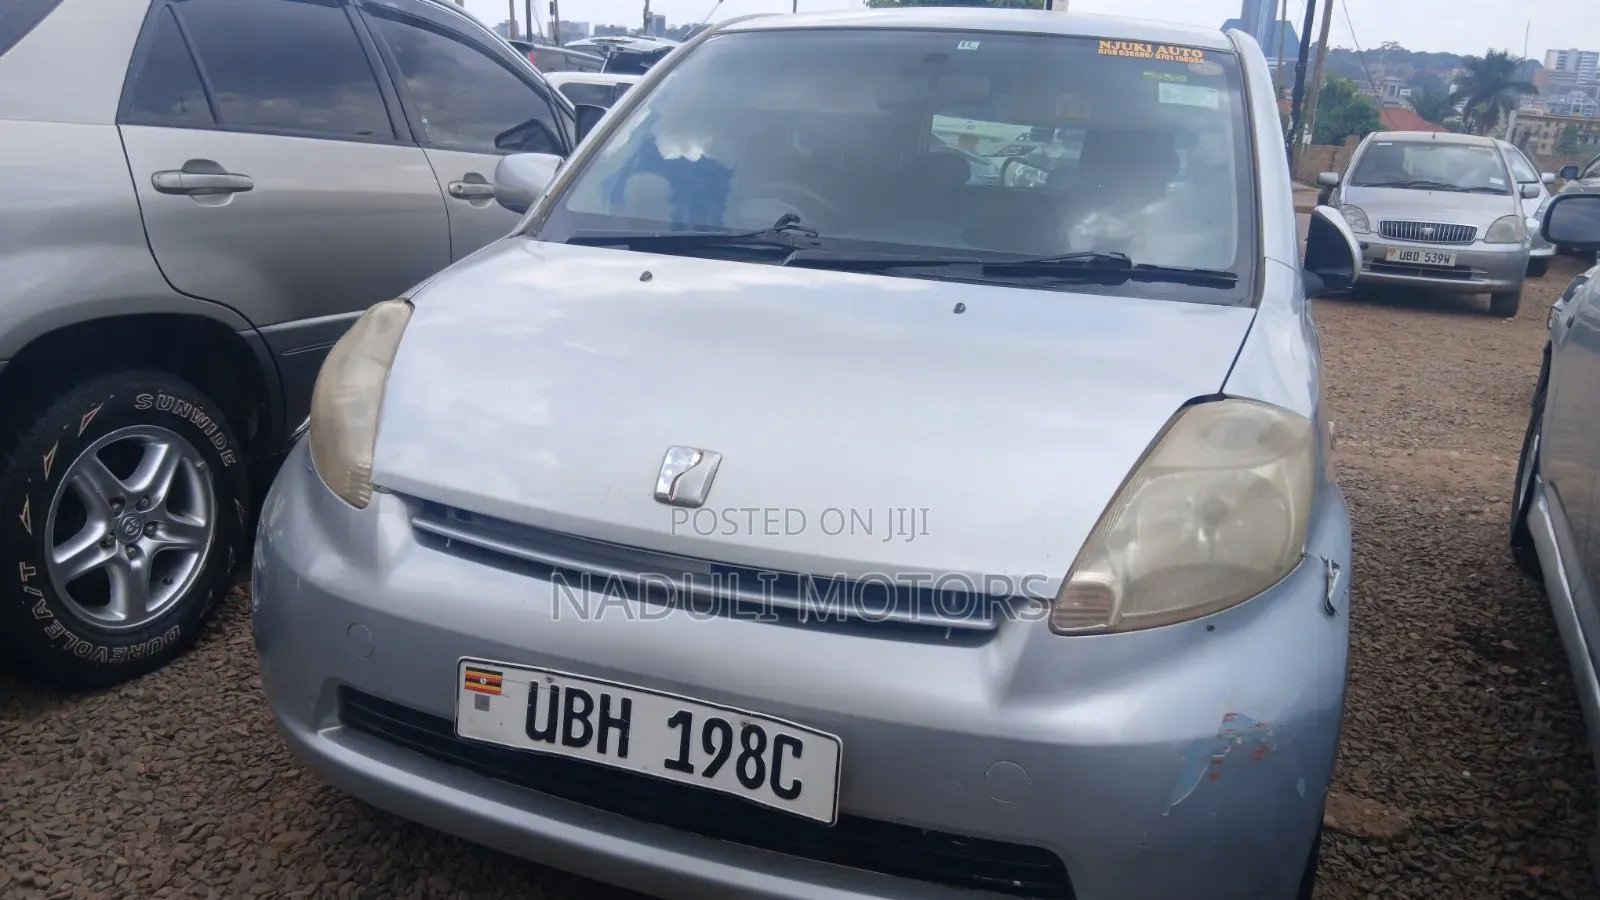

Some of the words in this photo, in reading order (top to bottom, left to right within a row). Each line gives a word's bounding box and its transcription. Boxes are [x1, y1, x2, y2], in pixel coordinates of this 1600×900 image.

[1099, 40, 1152, 53] NJUKI
[1156, 45, 1203, 58] AUTO
[1399, 250, 1419, 262] UBD
[1424, 253, 1451, 264] 539W
[134, 393, 236, 466] SUNWIDE
[525, 680, 632, 758] UBH
[664, 709, 803, 800] 198C
